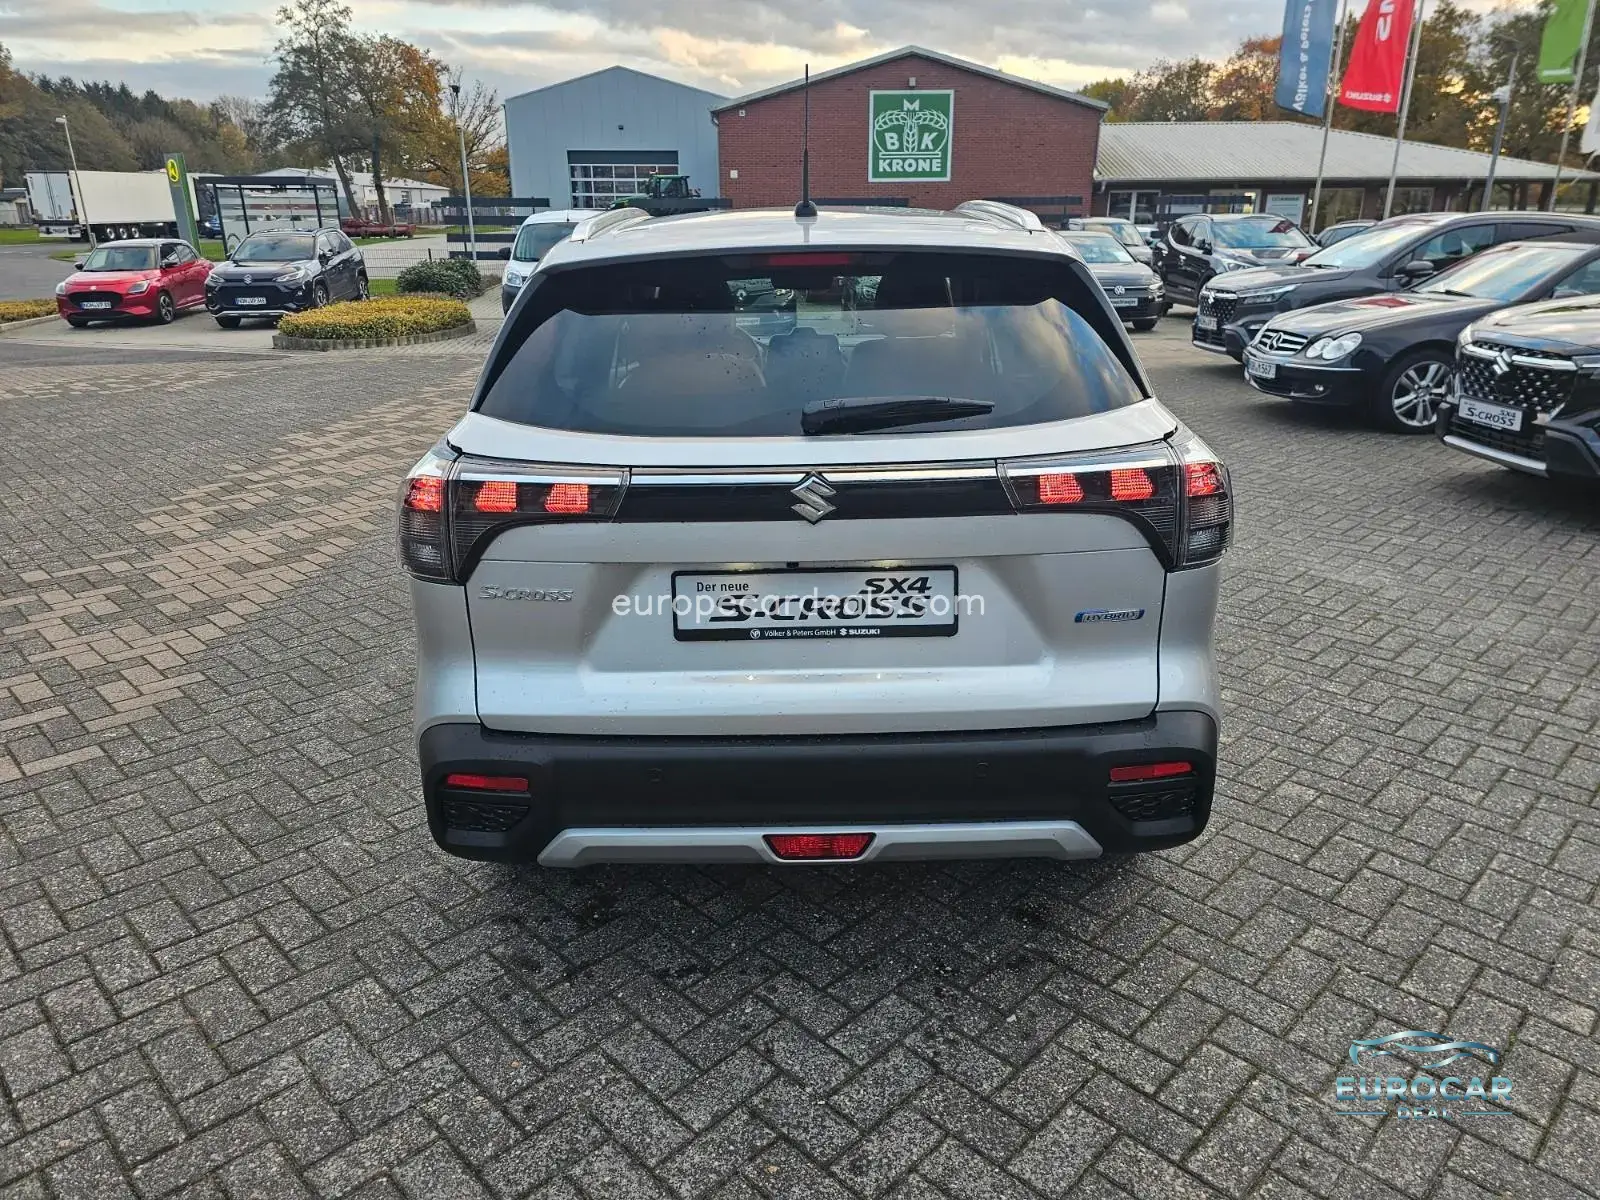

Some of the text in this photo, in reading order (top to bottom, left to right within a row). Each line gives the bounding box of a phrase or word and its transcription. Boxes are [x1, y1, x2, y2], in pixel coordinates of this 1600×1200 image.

[903, 99, 920, 111] M
[884, 132, 938, 150] B K
[878, 159, 942, 172] KRONE
[696, 582, 750, 592] Der neue
[859, 576, 932, 595] SX4
[1085, 610, 1139, 622] HYBRID
[792, 629, 814, 637] Peters
[814, 628, 837, 636] GmbH
